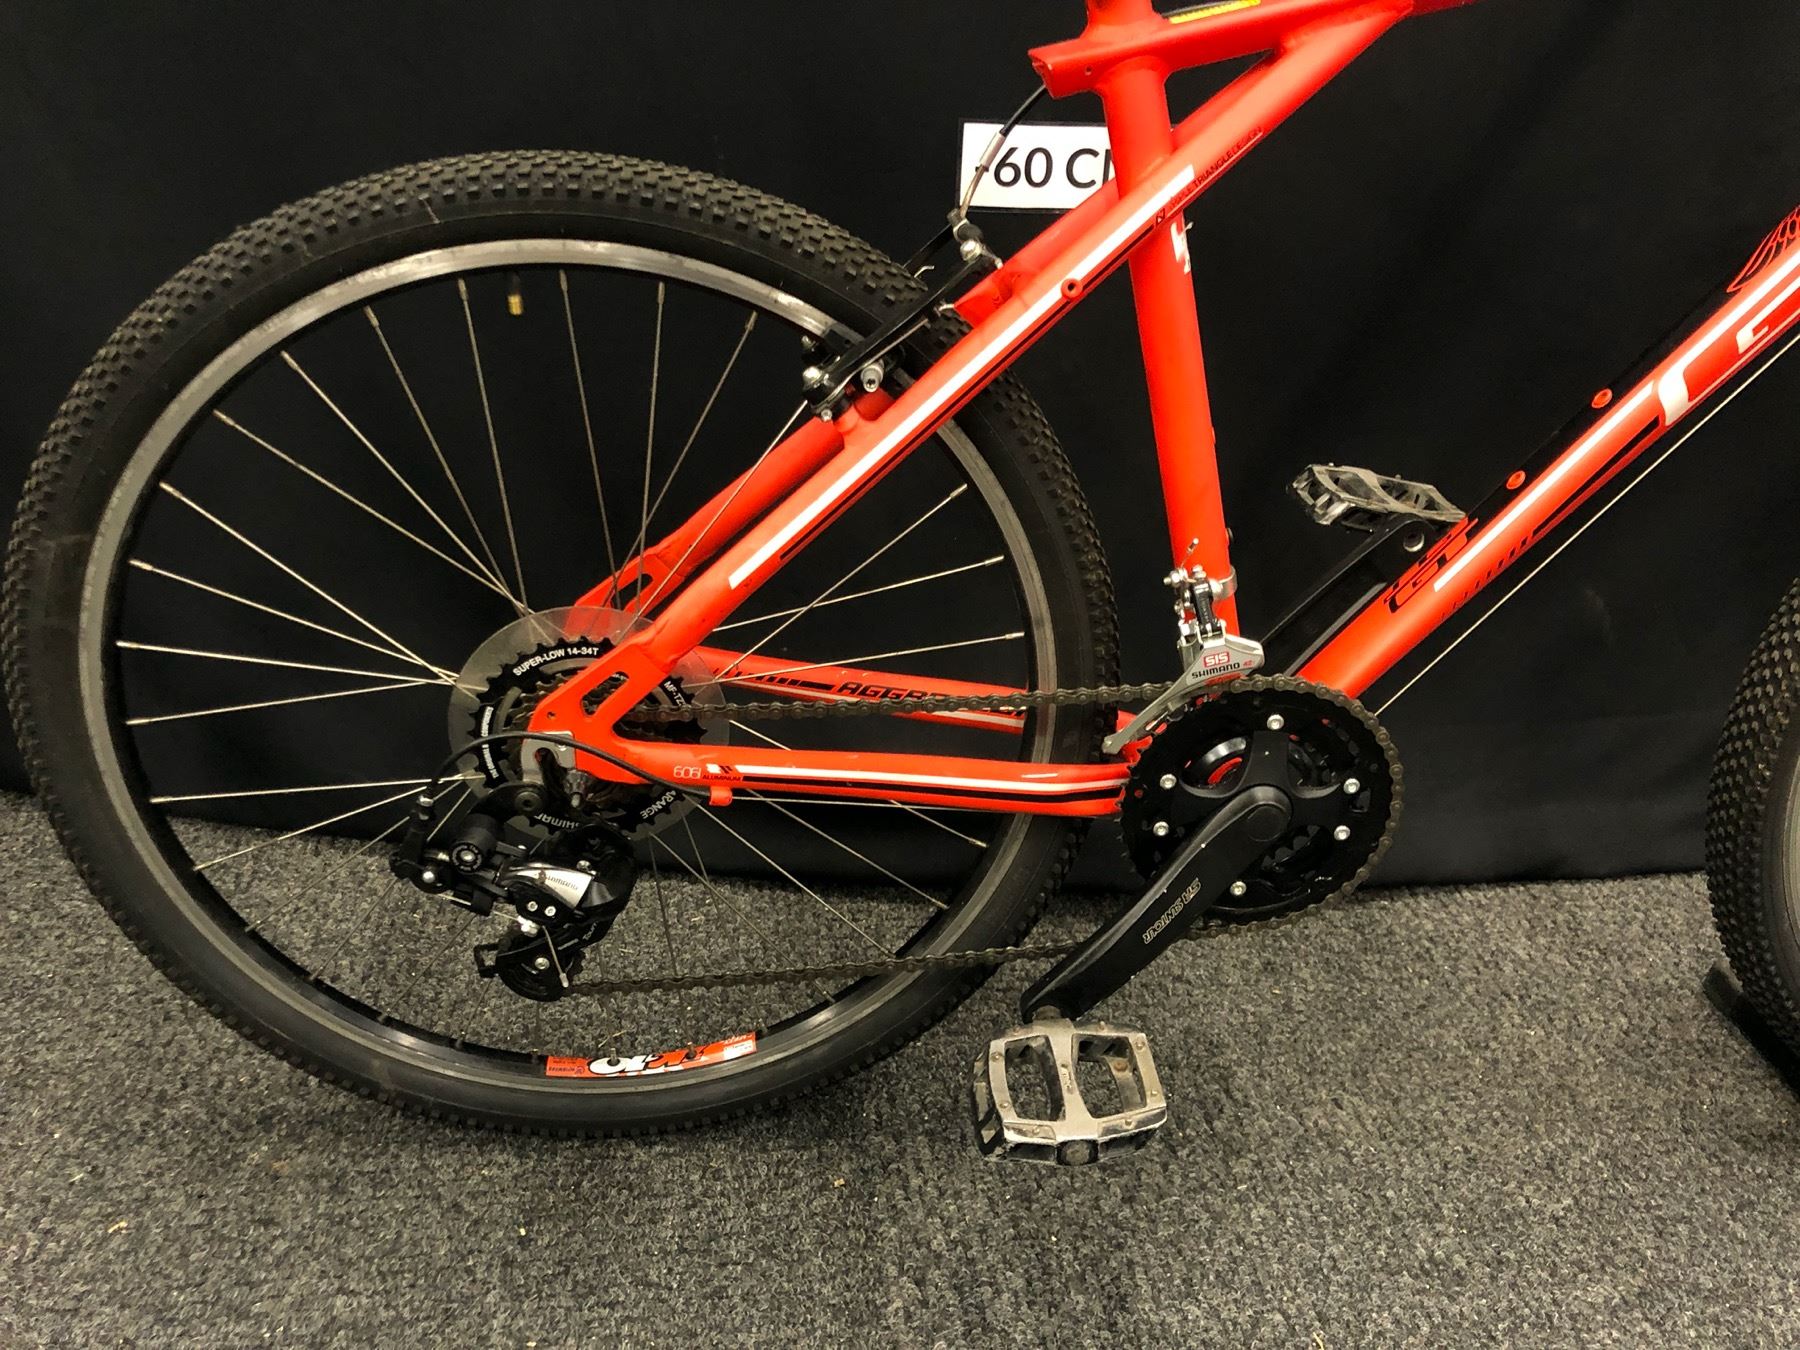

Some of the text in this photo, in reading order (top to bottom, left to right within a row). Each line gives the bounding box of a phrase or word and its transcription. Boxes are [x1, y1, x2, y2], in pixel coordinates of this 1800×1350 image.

[1066, 148, 1115, 189] C
[1193, 149, 1235, 188] TRIANGLE
[512, 647, 599, 676] SUPER-LOW 14-34T
[1191, 662, 1241, 679] SHIMANO
[1204, 653, 1229, 666] SIS
[663, 680, 687, 706] MF-TZ
[1142, 897, 1184, 945] SUNTOUR
